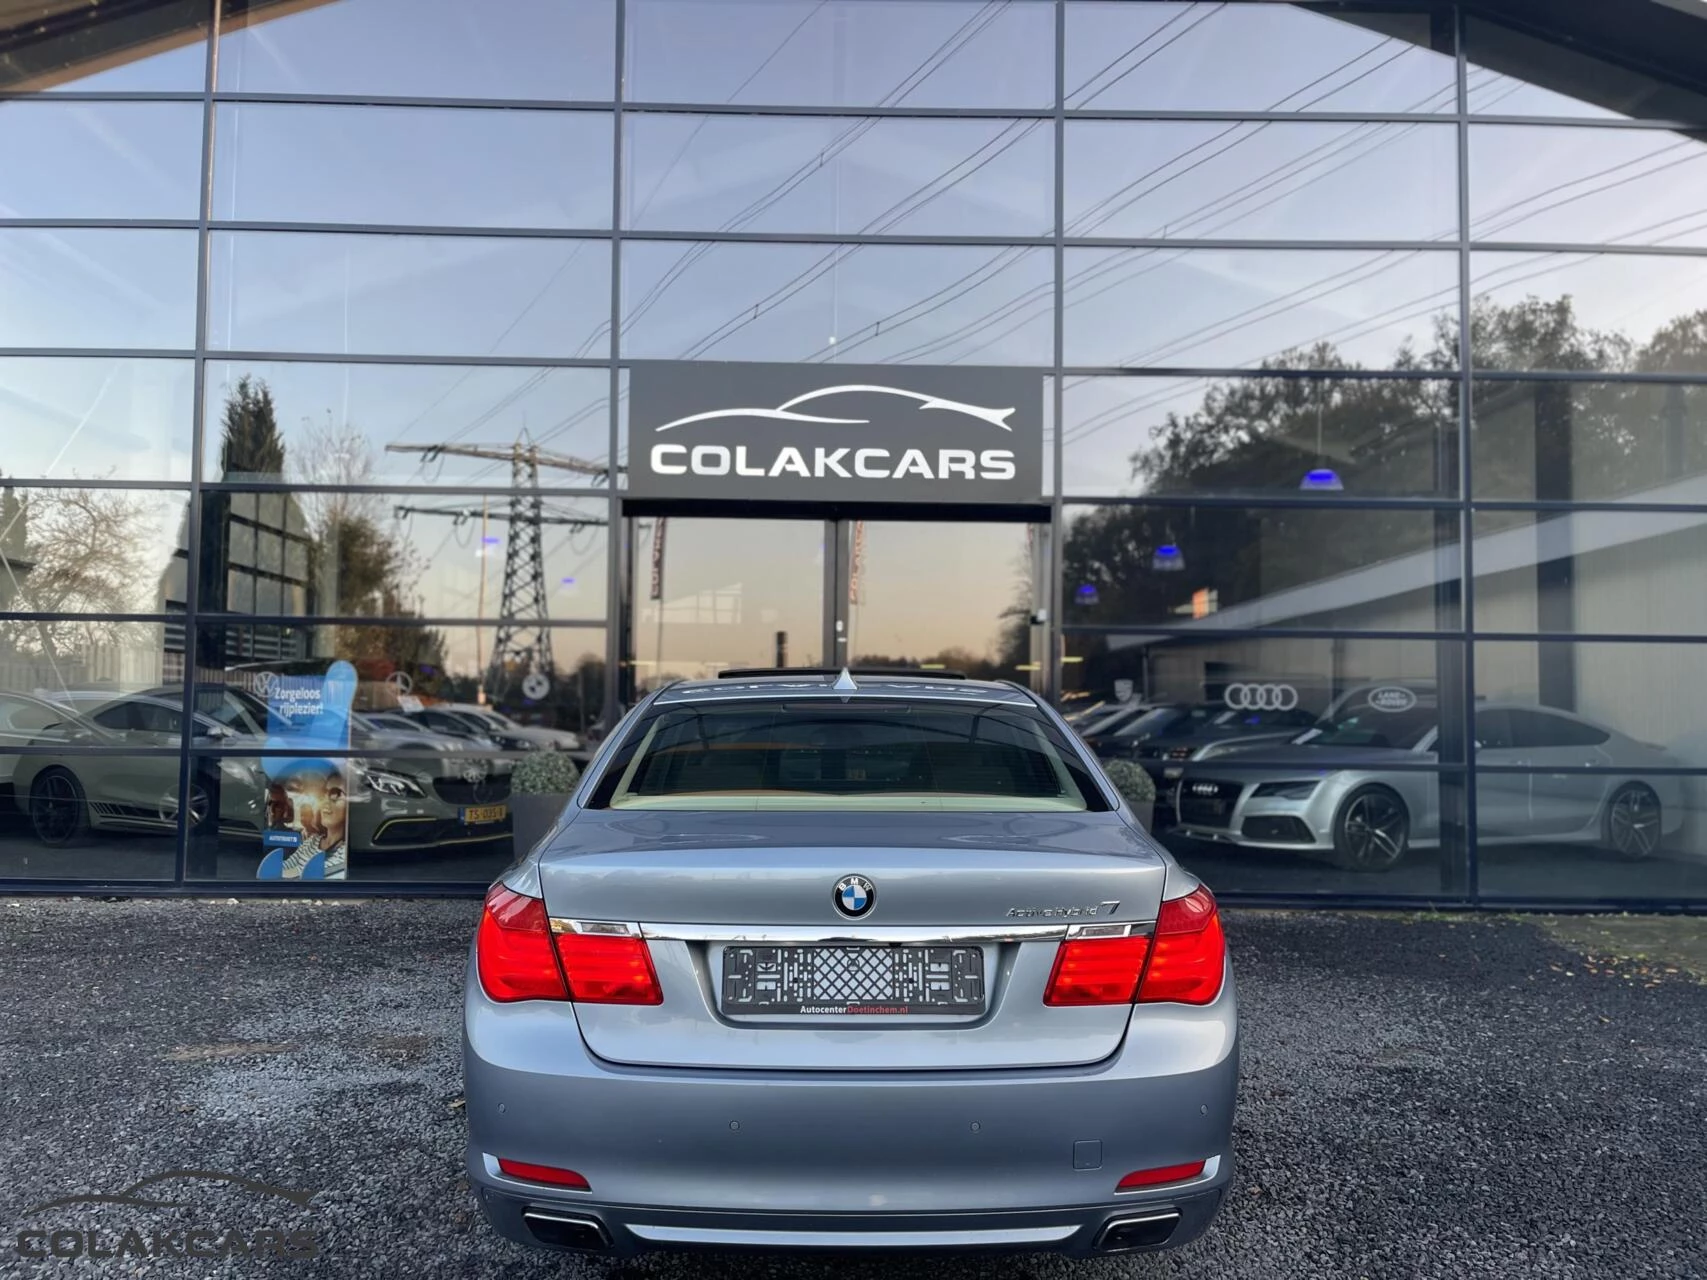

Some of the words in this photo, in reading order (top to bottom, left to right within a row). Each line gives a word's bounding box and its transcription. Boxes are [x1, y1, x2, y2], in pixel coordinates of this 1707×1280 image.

[650, 443, 1016, 480] COLAKCARS
[274, 686, 321, 703] Zorgeloos
[279, 702, 324, 718] rijplezier!
[838, 877, 873, 891] BMW
[1101, 900, 1121, 915] 7
[800, 1004, 908, 1015] AutocenterDoetinchem.nl
